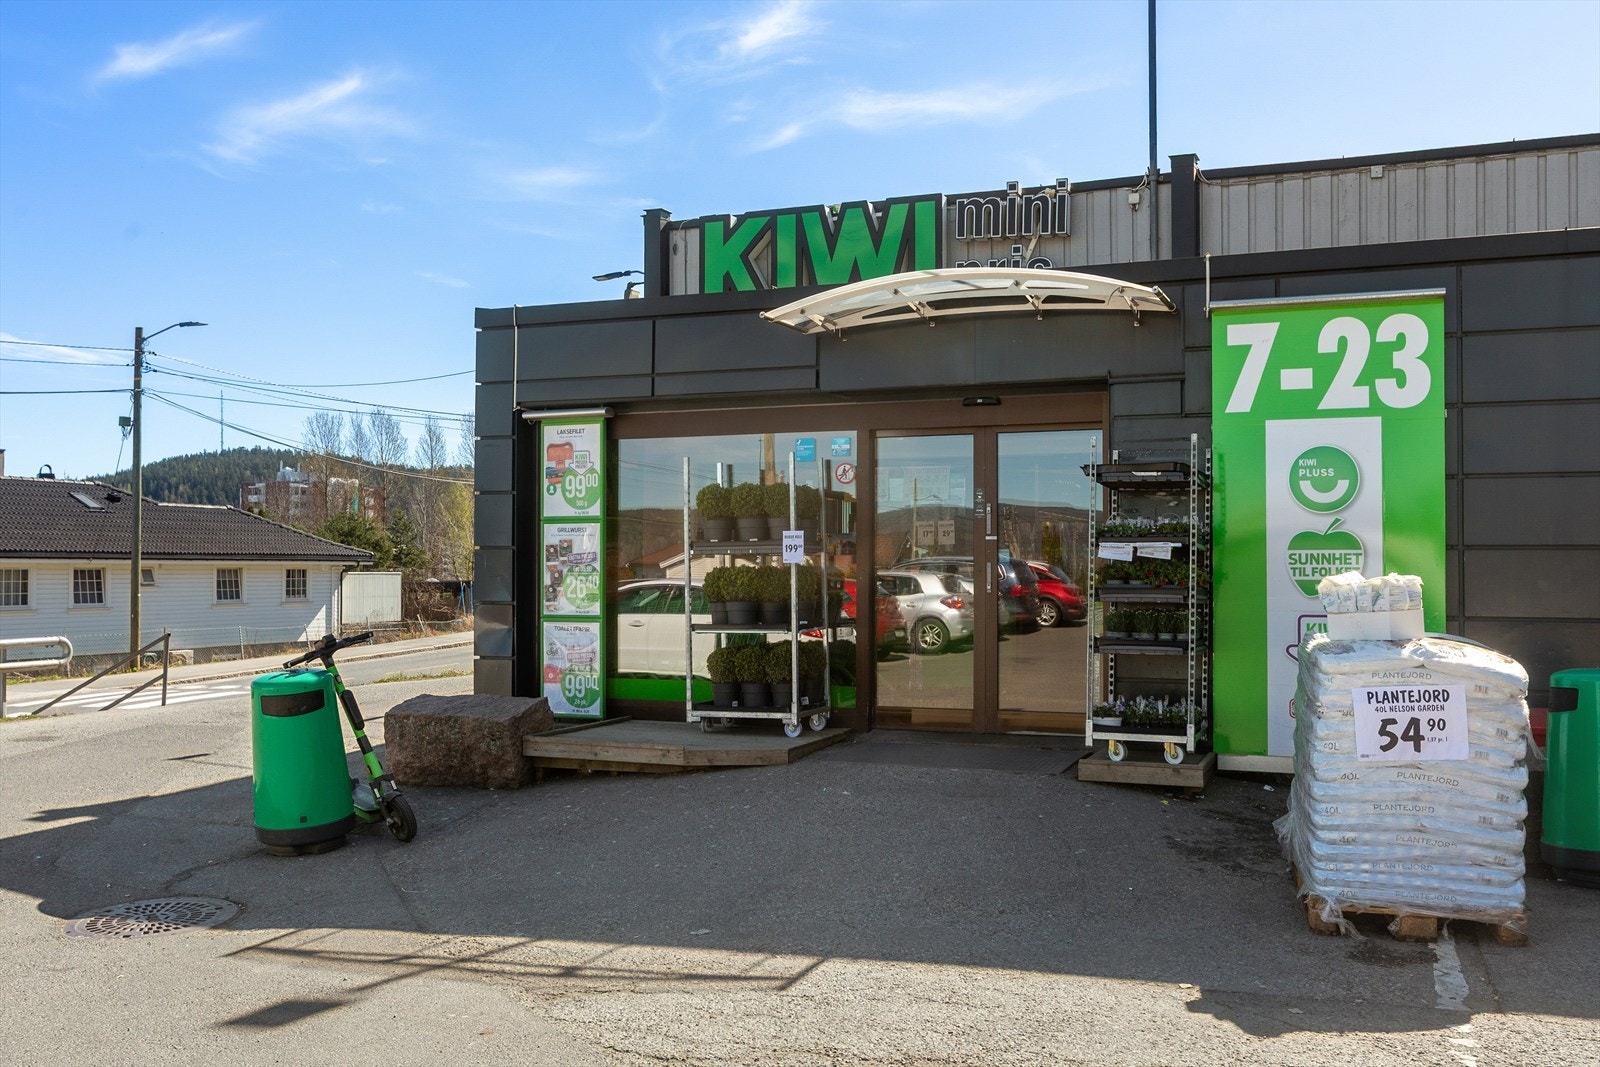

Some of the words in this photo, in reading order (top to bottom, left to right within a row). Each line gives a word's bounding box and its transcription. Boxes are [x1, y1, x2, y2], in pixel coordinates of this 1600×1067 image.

[955, 179, 1070, 239] mini
[702, 198, 938, 294] KIWI
[1224, 313, 1431, 413] 7-23
[1299, 458, 1317, 466] KIWI
[1299, 468, 1335, 477] PLUSS
[565, 475, 585, 498] 99
[785, 544, 798, 552] 199
[1288, 552, 1363, 565] SUNNHET
[1290, 567, 1309, 577] TIL
[1311, 567, 1360, 577] FOLK
[1371, 671, 1432, 680] PLANTEJORD
[565, 675, 586, 698] 99
[1366, 689, 1450, 705] PLANTEJORD
[1374, 705, 1388, 713] 40L
[1389, 704, 1415, 713] NELSON
[1417, 704, 1445, 713] GARDEN
[1378, 717, 1425, 753] 54
[1427, 718, 1447, 731] 90
[1396, 771, 1460, 787] PLANTEJORD
[1373, 803, 1435, 814] PLANTEJORD
[1395, 835, 1458, 848] PLANTEJORD
[1372, 861, 1434, 872] PLANTEJORD
[1395, 890, 1458, 903] PLANTEJORD
